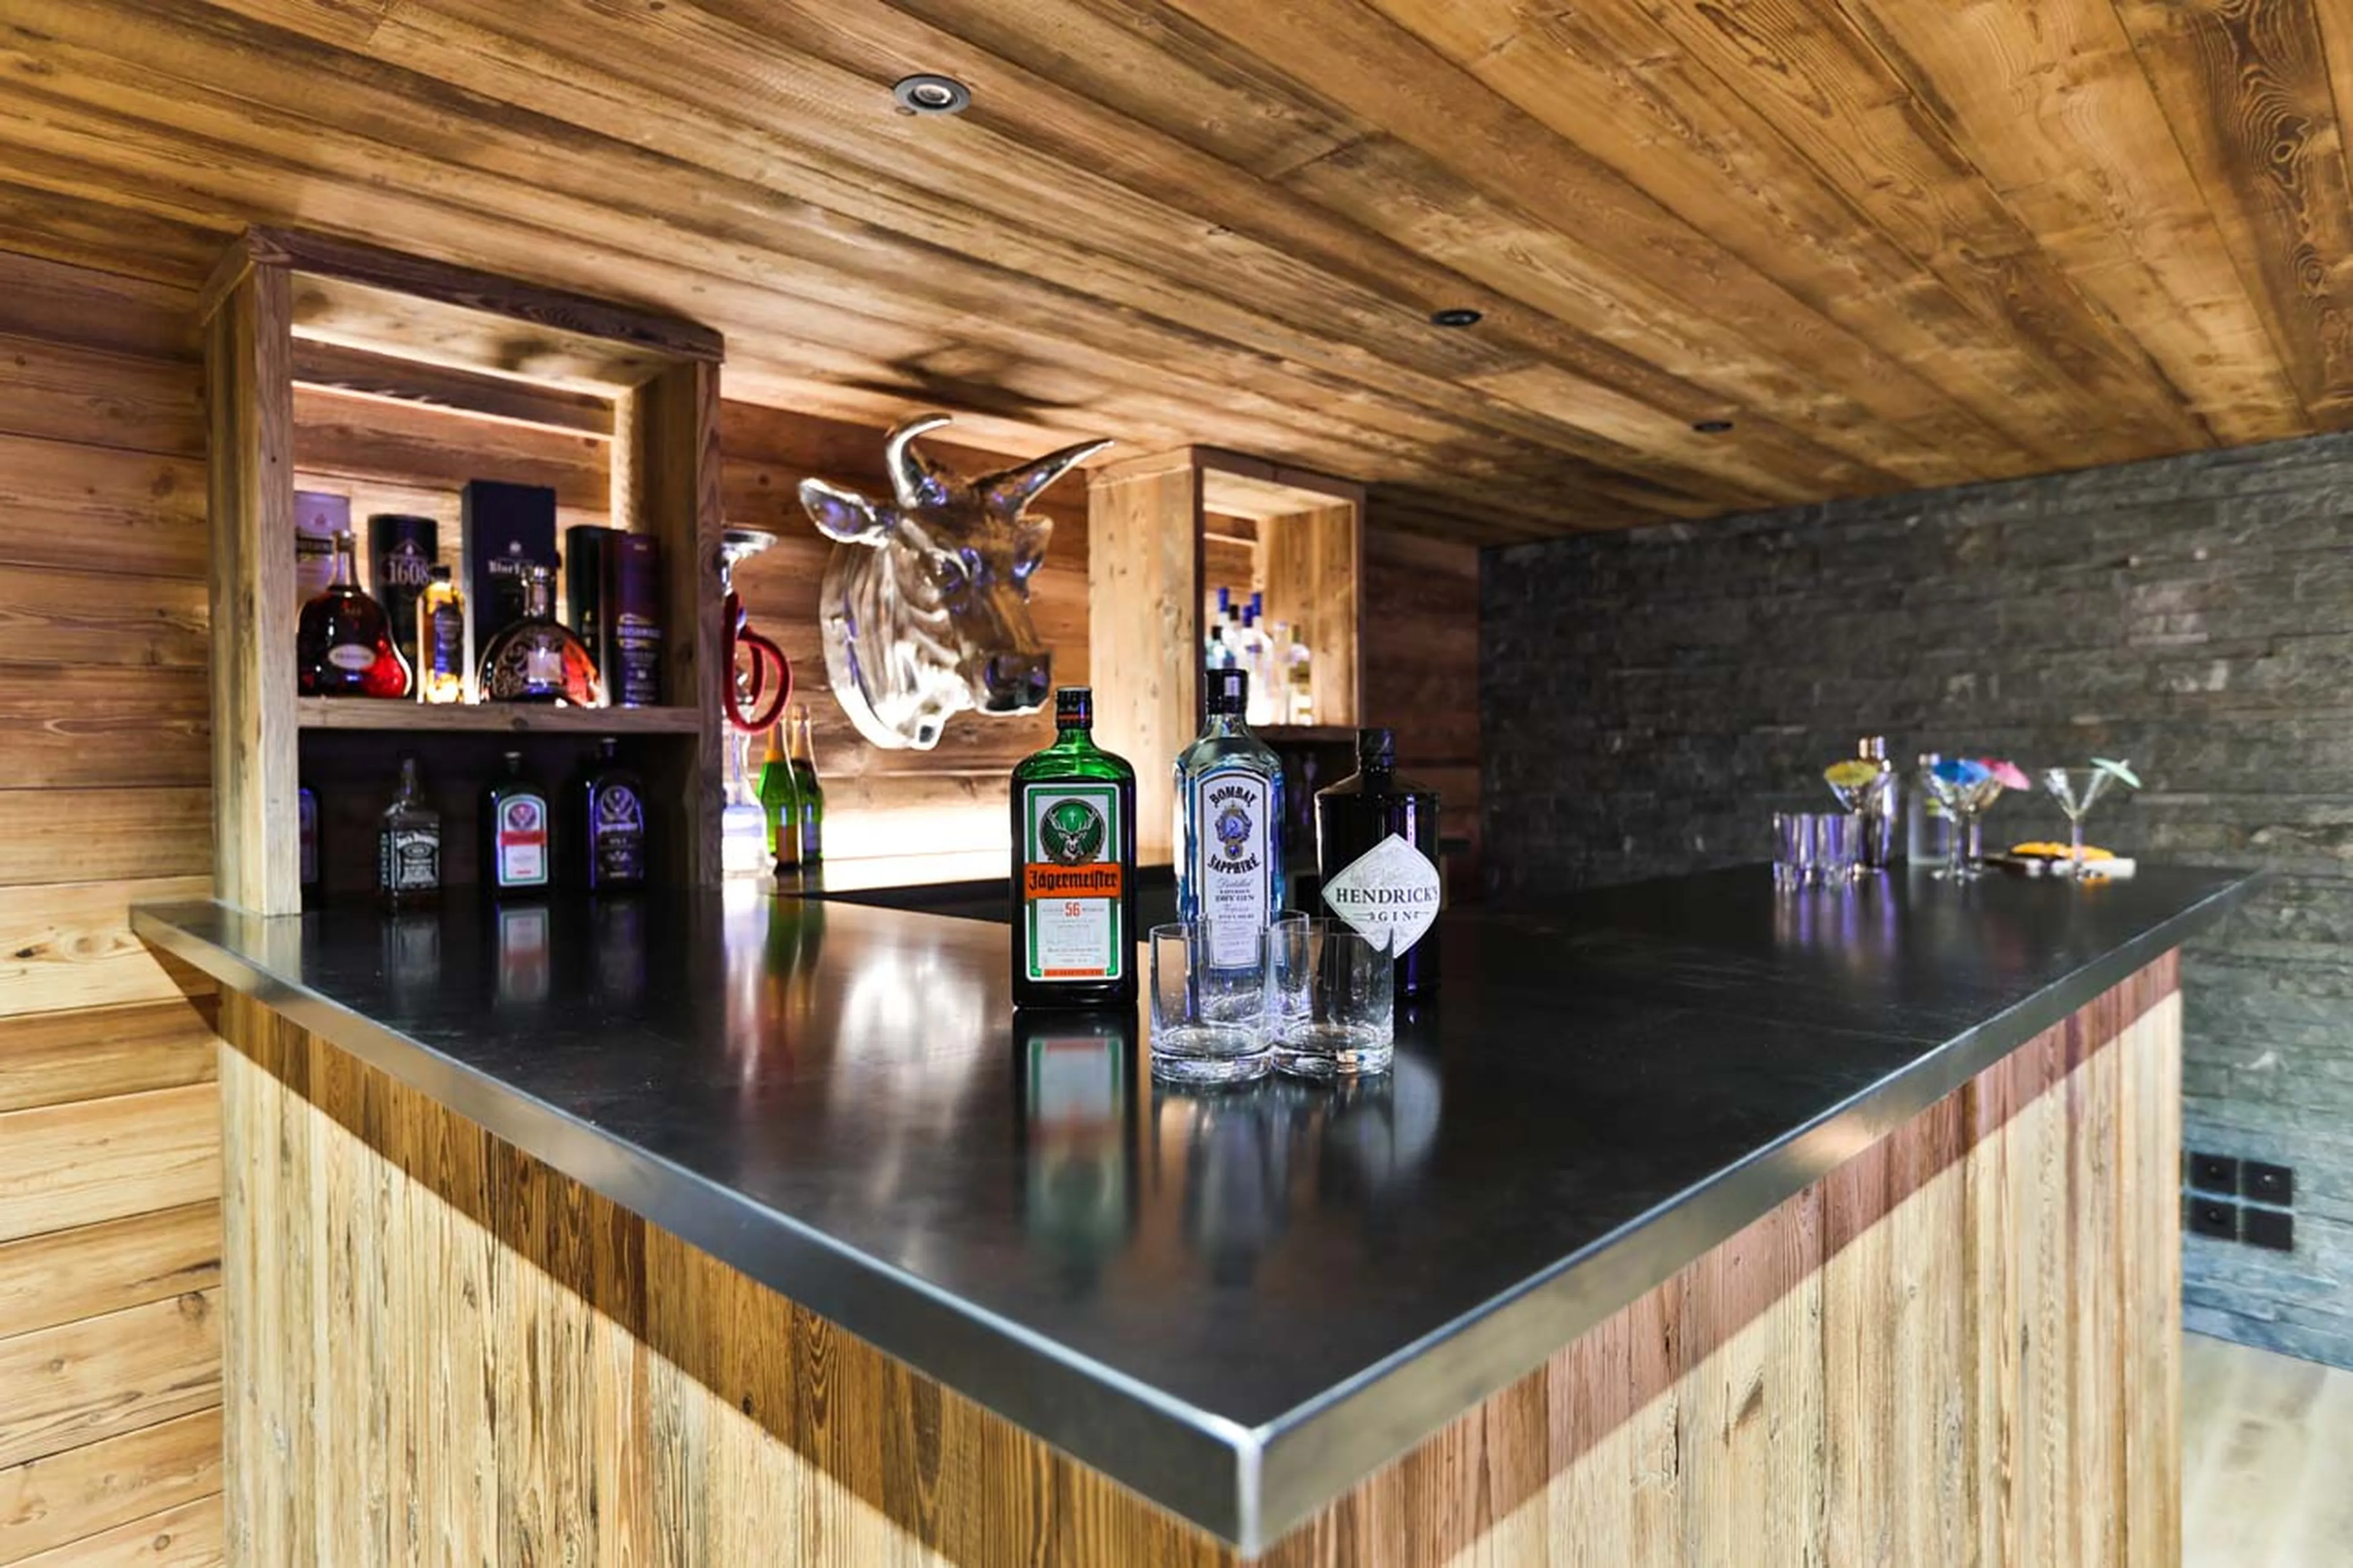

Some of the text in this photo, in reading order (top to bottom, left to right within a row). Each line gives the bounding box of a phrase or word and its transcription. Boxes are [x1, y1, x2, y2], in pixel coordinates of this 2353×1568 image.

[389, 560, 430, 585] 1608
[1209, 786, 1257, 808] BOMBAY
[1207, 852, 1261, 874] SAPPHIRE
[1029, 870, 1118, 891] Jägermeister
[1065, 902, 1080, 917] 56
[1378, 911, 1412, 922] GIN
